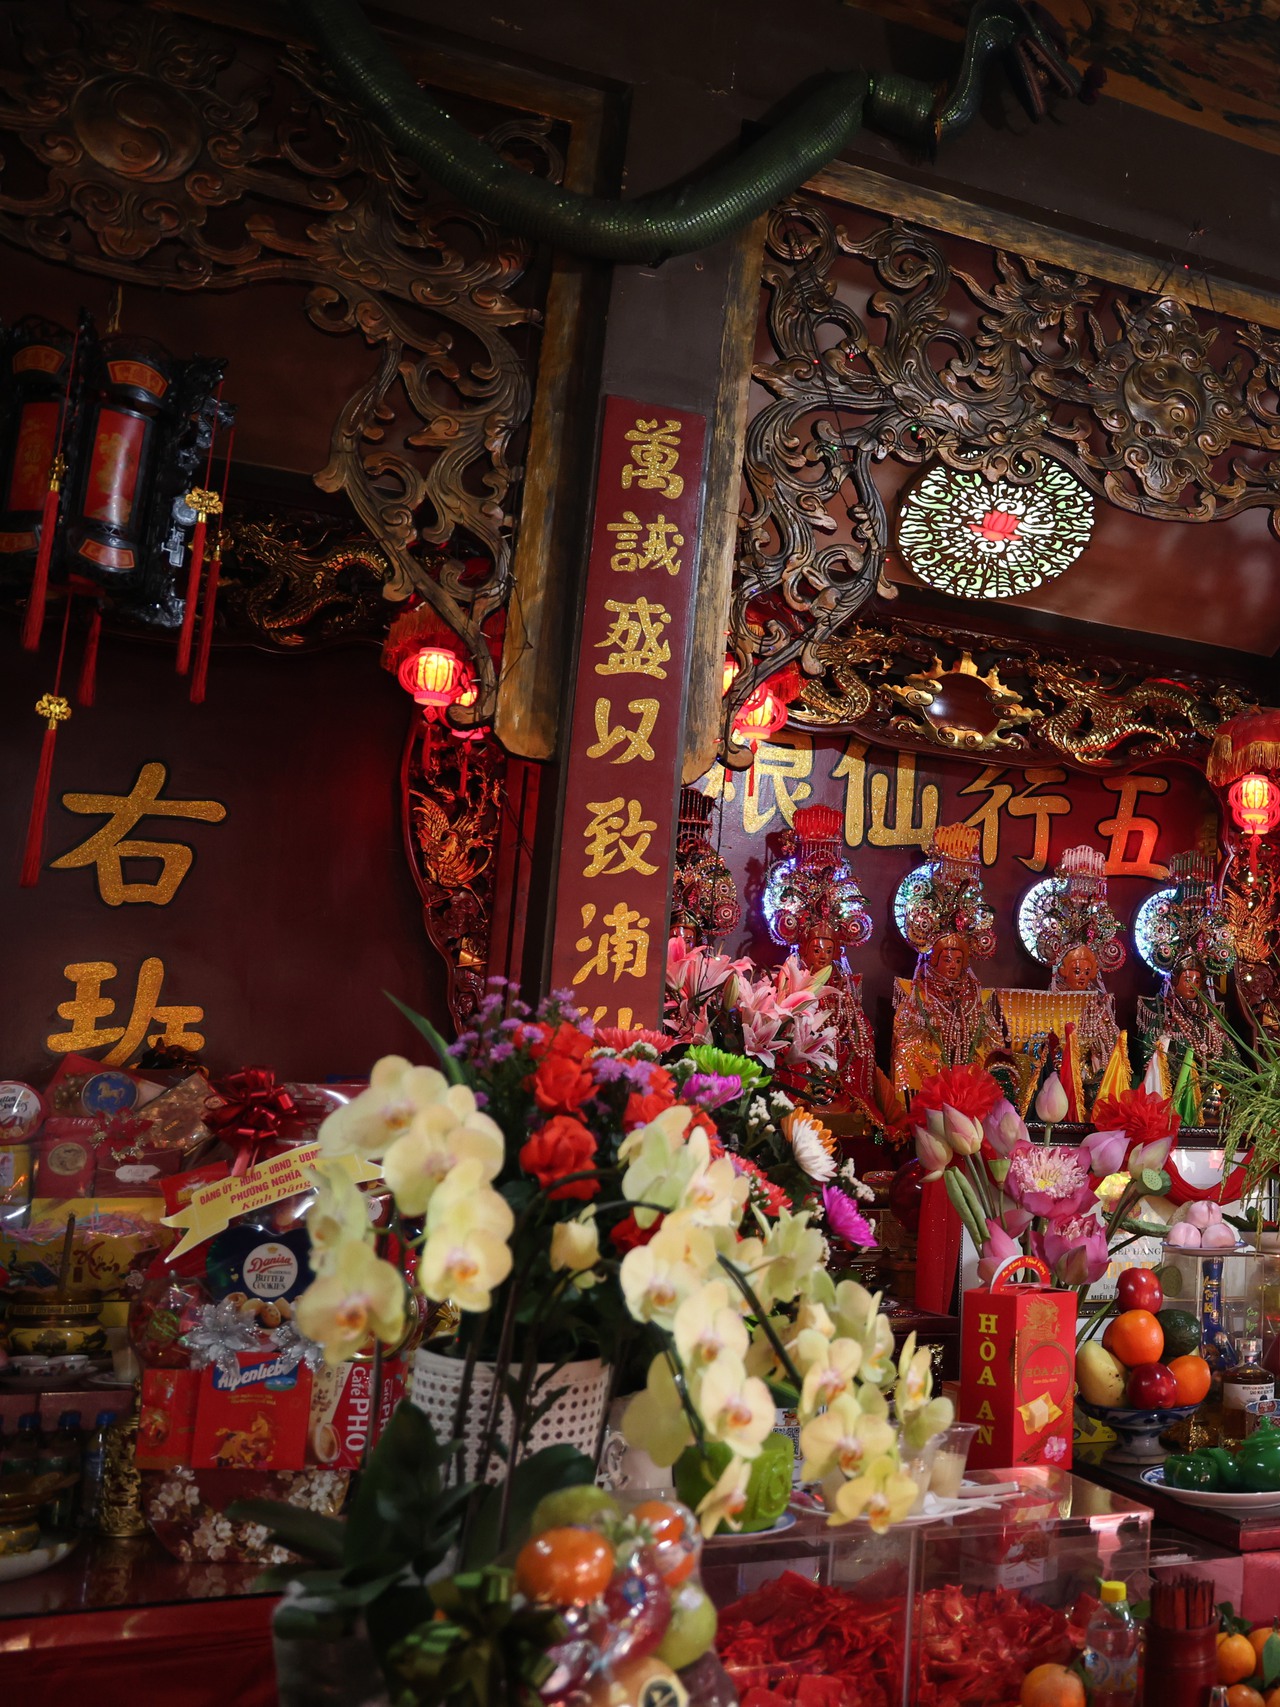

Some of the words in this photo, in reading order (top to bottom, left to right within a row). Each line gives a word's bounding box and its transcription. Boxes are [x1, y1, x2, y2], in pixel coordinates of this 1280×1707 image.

[268, 1159, 292, 1175] UBND
[230, 1182, 270, 1204] PHƯỜNG
[272, 1169, 302, 1191] NGHĨA
[242, 1194, 272, 1210] Kính
[247, 1253, 293, 1273] Danisa
